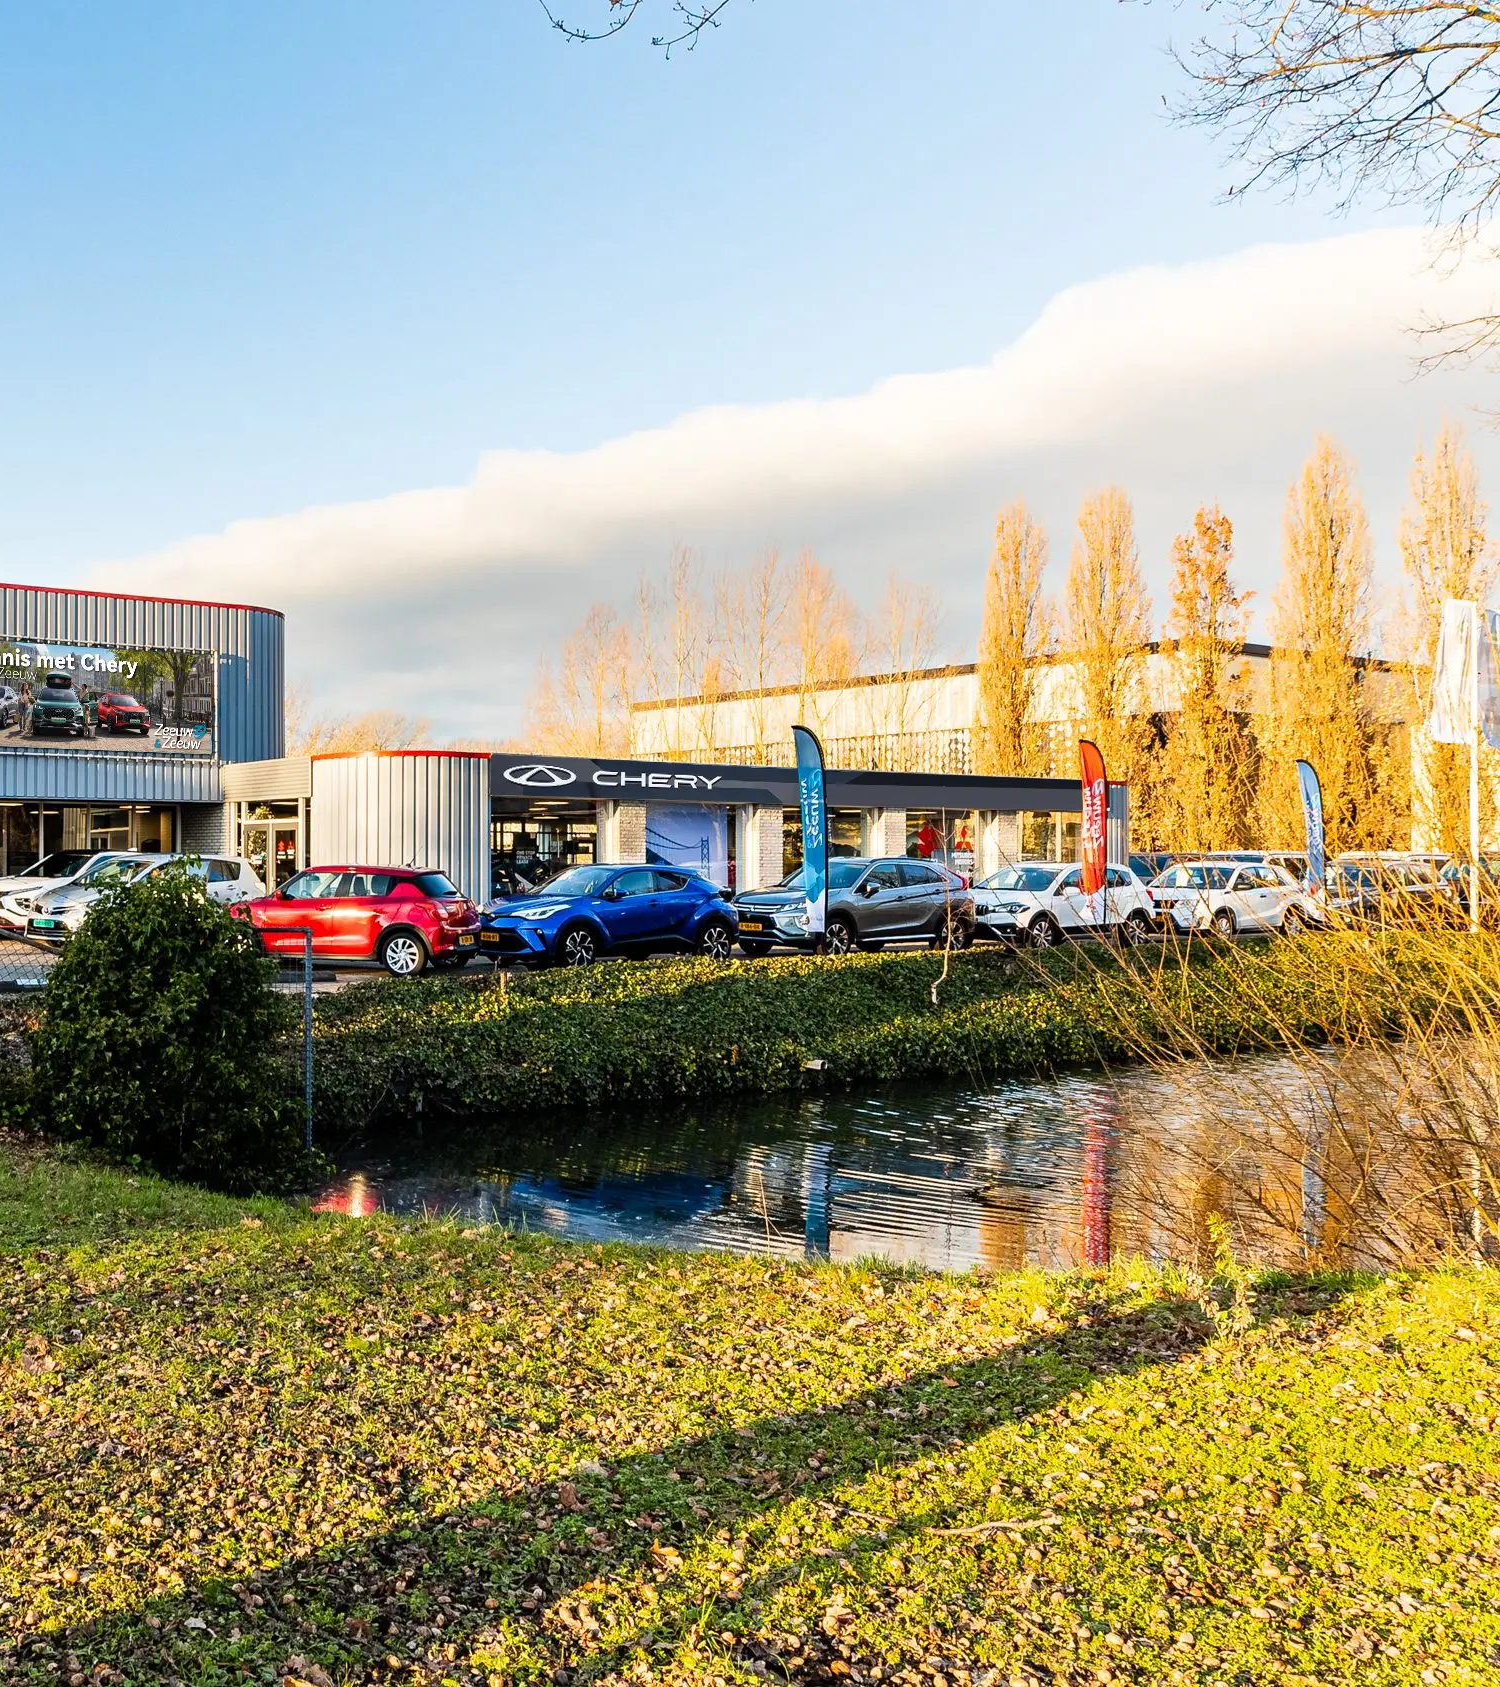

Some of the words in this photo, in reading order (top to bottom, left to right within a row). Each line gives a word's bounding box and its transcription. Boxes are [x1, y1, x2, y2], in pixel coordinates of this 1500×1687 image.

[37, 653, 75, 670] met
[81, 653, 138, 678] Chery
[154, 723, 194, 737] Zeeuw
[162, 736, 201, 749] Zeeuw
[592, 770, 722, 790] CHERY
